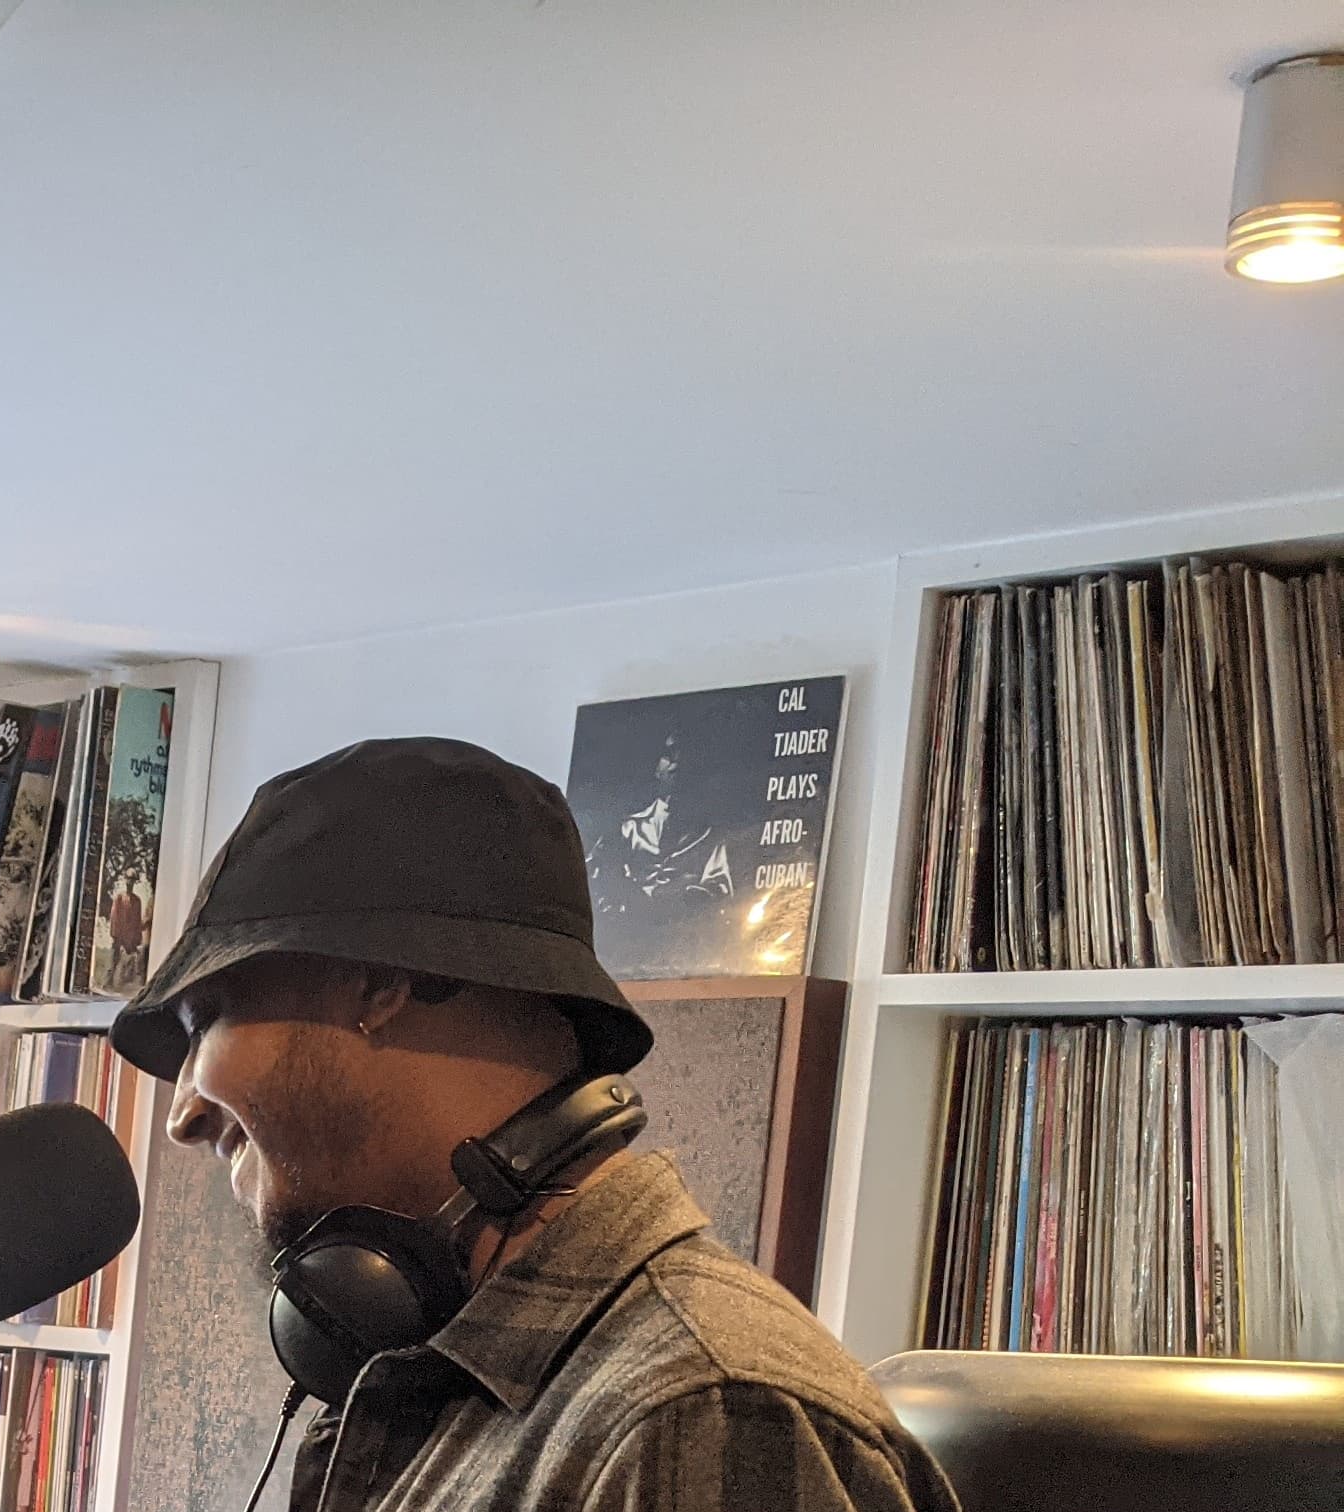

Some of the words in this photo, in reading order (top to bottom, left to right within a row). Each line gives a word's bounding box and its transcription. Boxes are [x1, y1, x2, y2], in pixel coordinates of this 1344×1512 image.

[778, 686, 807, 712] CAL
[774, 728, 829, 757] TJADER
[767, 773, 818, 801] PLAYS
[760, 818, 808, 845] AFRO-
[755, 862, 808, 889] CUBAN
